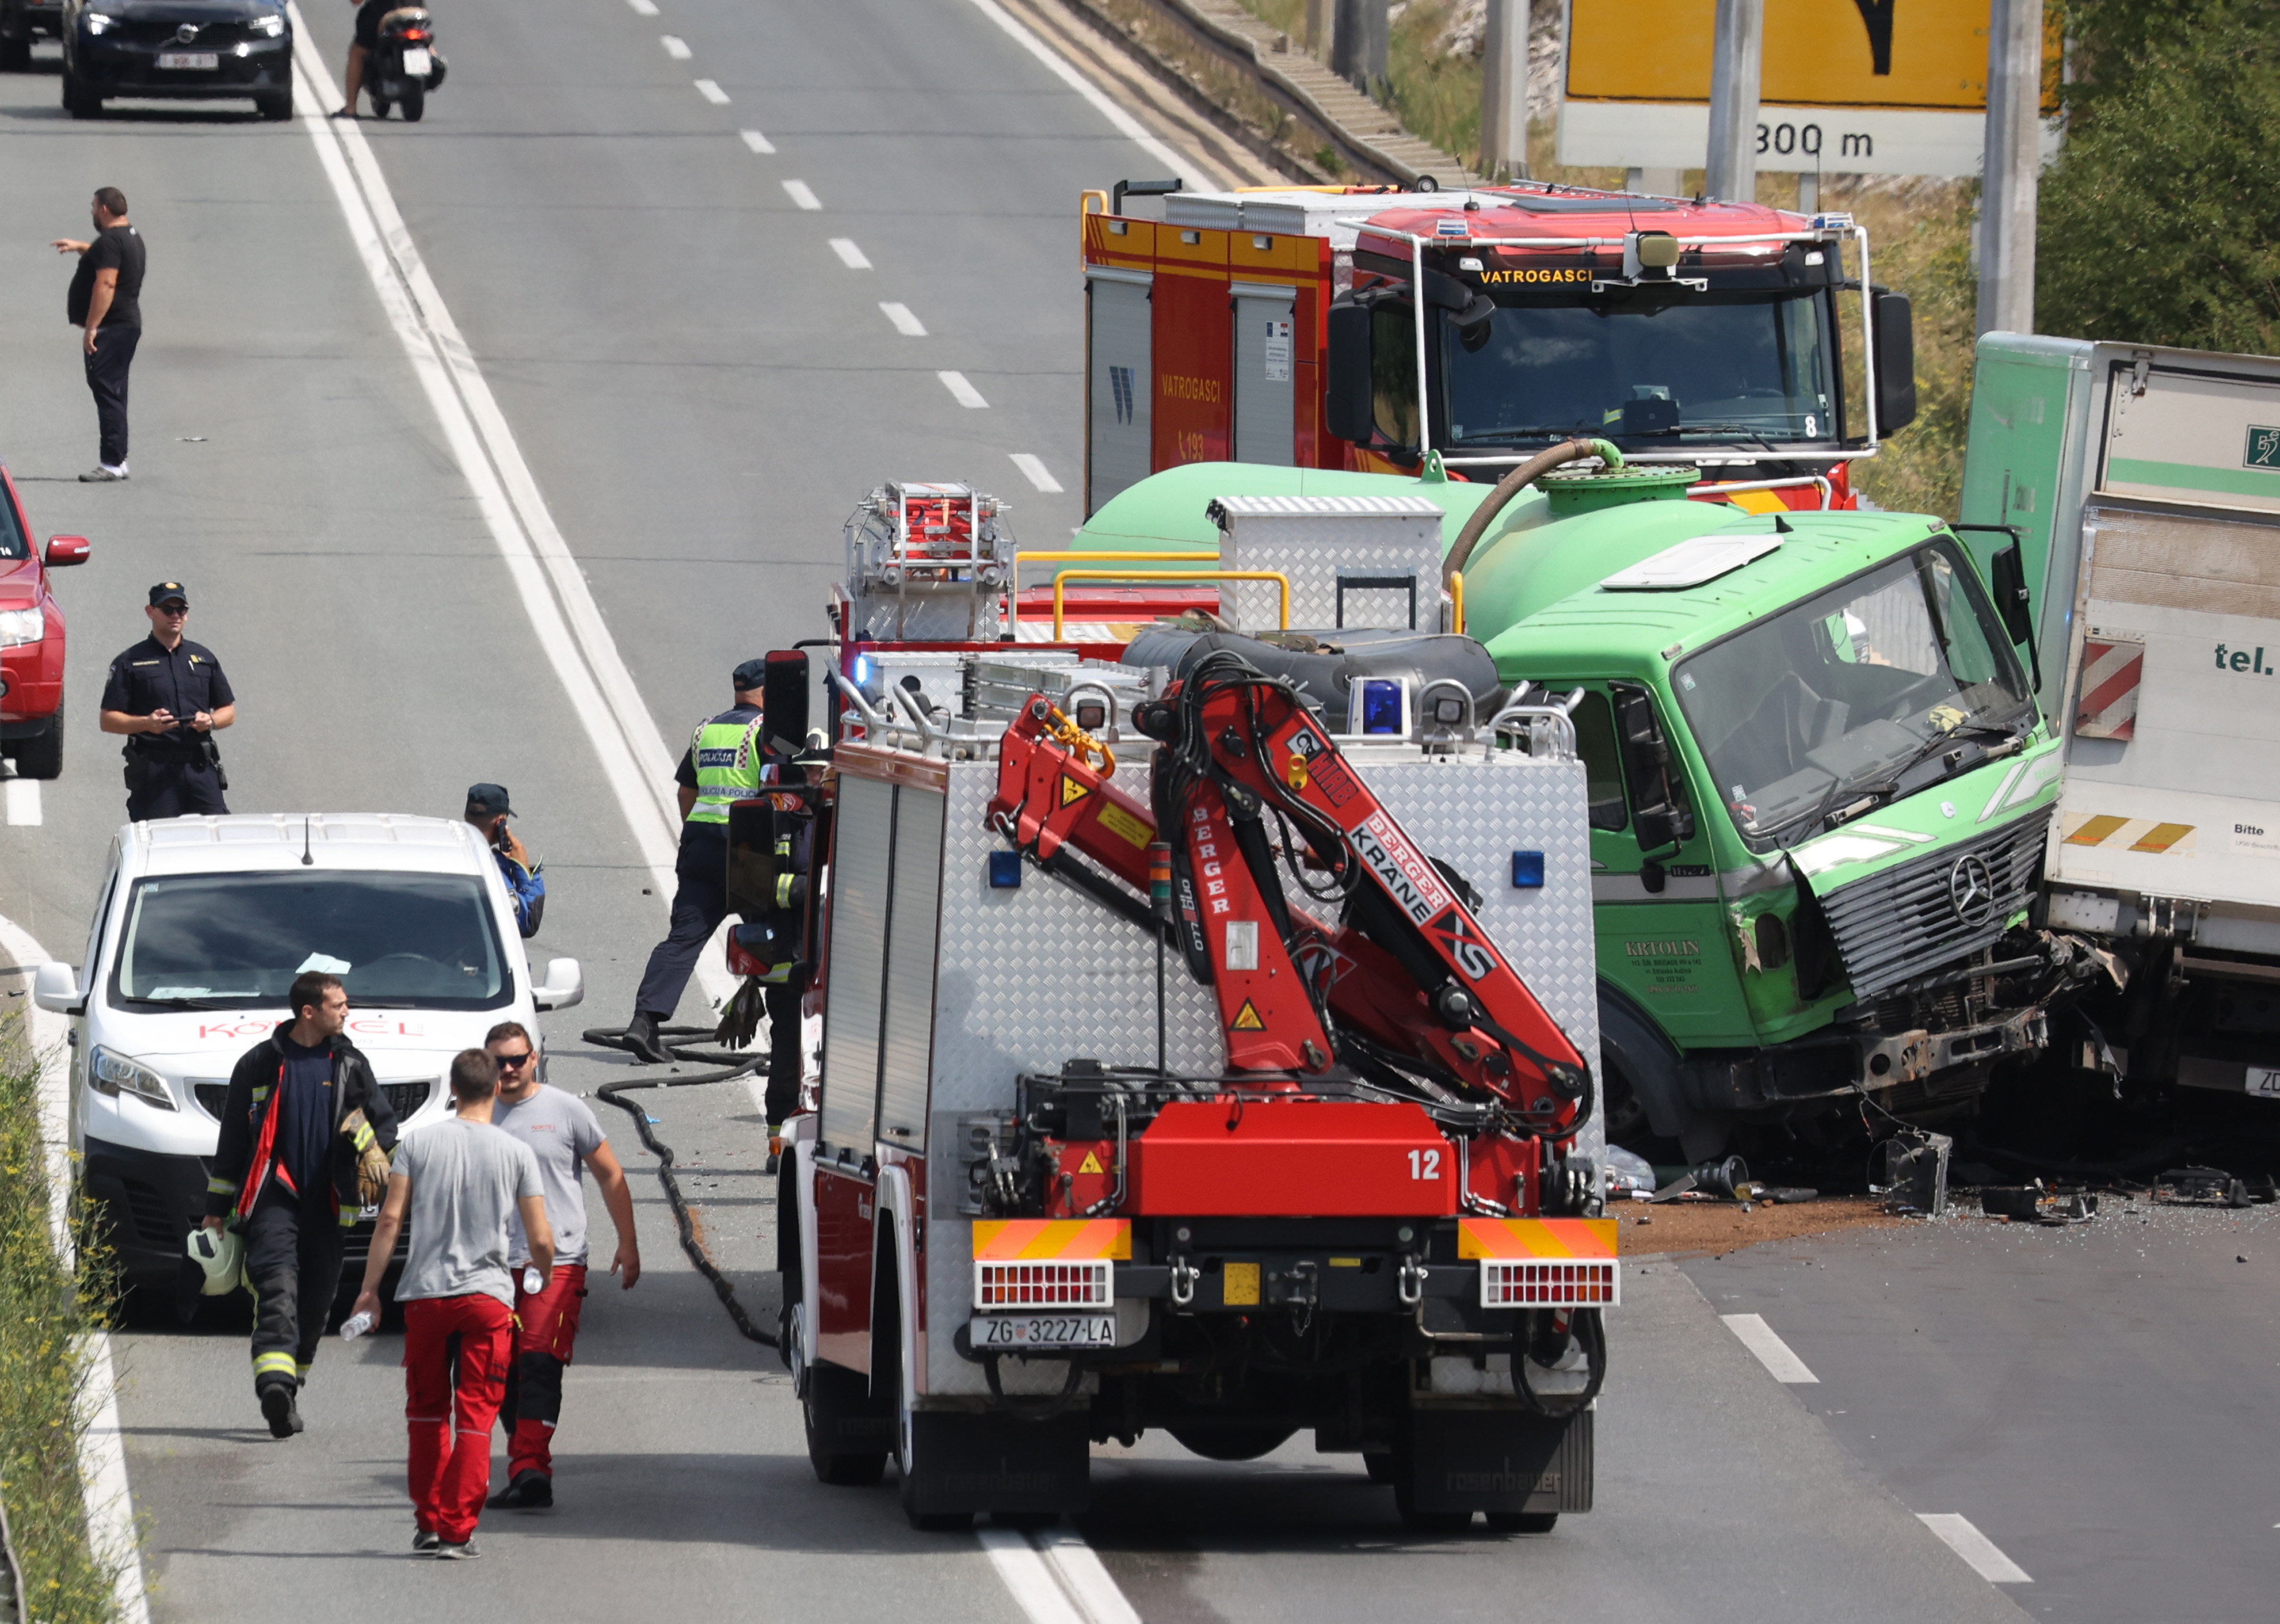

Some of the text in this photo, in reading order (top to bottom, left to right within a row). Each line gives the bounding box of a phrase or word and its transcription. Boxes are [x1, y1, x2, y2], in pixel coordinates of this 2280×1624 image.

[1841, 133, 1872, 157] m
[1480, 269, 1593, 283] VATROGASCI
[1162, 374, 1220, 403] VATROGASCI
[1805, 415, 1817, 438] 8
[1187, 432, 1204, 462] 193
[2214, 643, 2274, 676] tel.
[699, 752, 733, 763] POLICIJA
[1307, 752, 1358, 807] HIAB
[2234, 823, 2264, 836] Bitte
[1193, 807, 1230, 914] BERGER
[1351, 827, 1432, 923] KRÄNE
[1368, 814, 1445, 910] BERGER
[1625, 940, 1701, 956] KRTOLIN
[1408, 1149, 1440, 1180] 12
[987, 1320, 1013, 1343] ZG
[1447, 1455, 1562, 1492] rosenbauer
